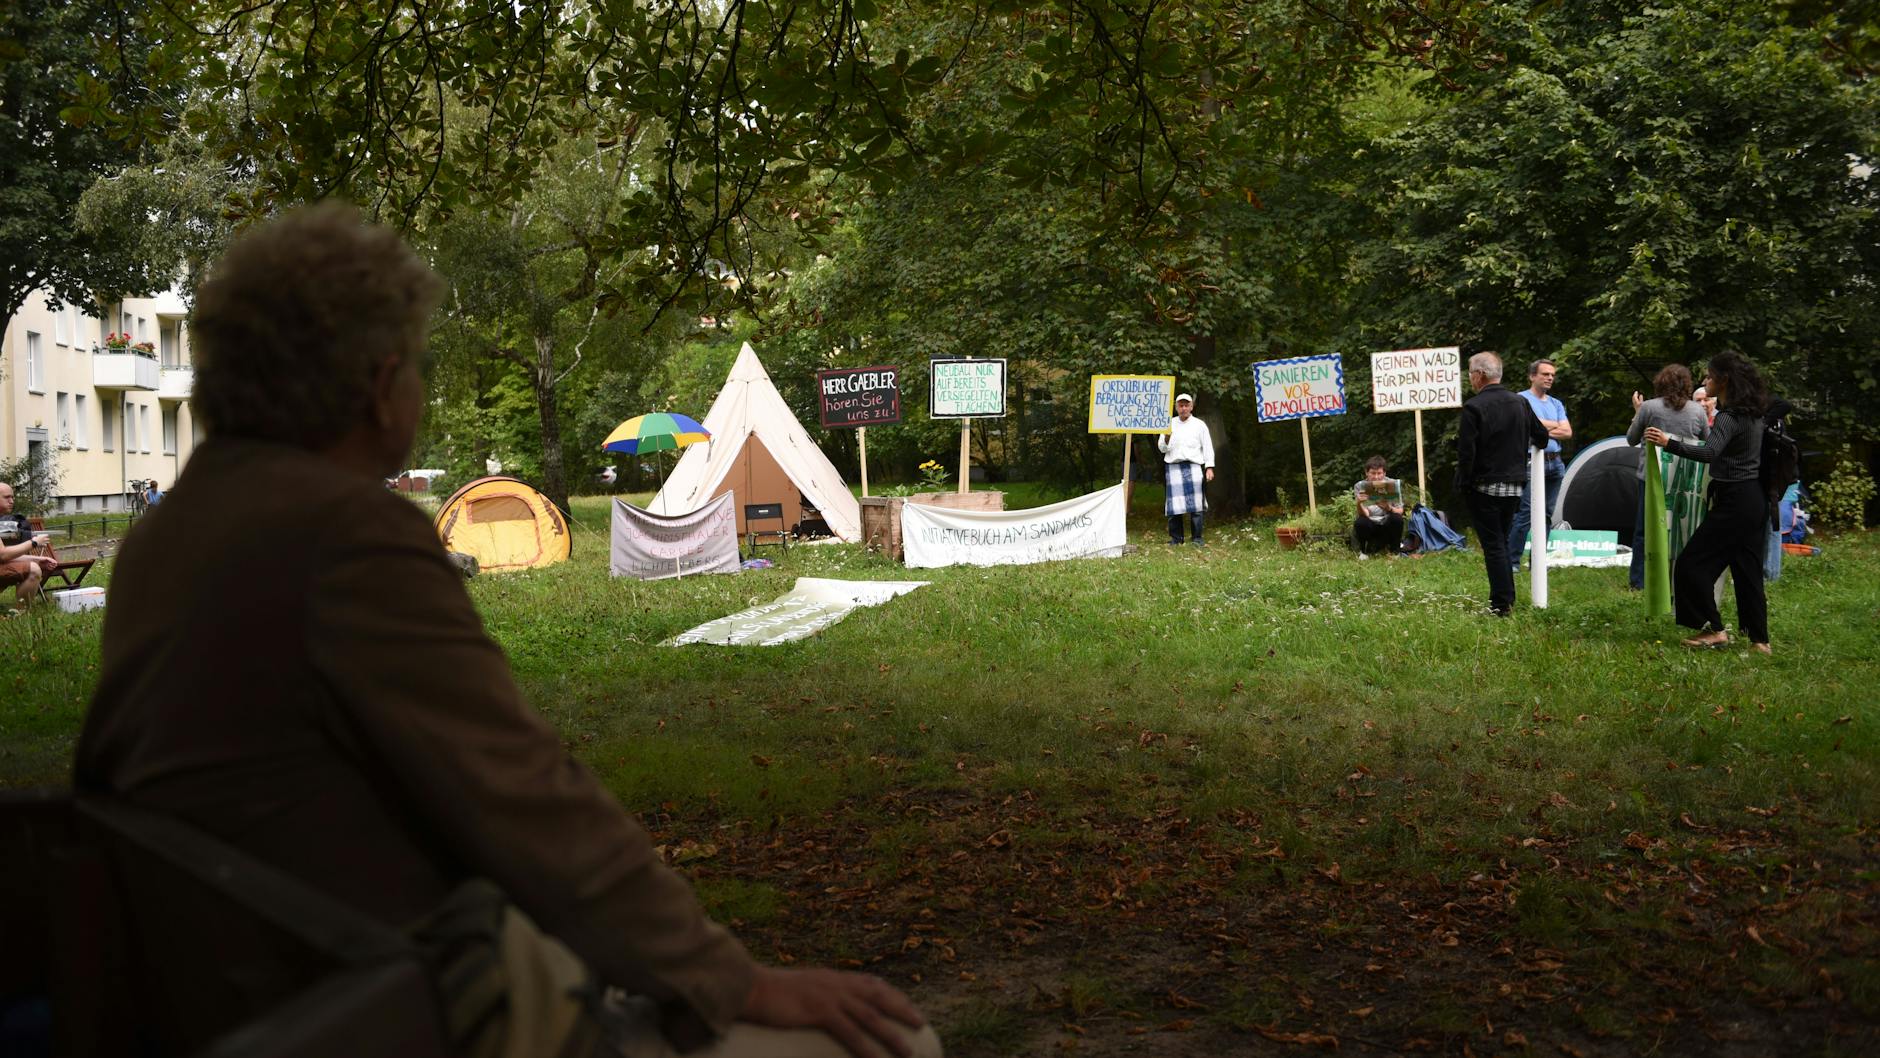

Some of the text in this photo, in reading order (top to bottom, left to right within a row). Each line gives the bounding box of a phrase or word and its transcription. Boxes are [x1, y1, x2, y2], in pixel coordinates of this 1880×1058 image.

[1375, 352, 1458, 371] KEINEN WALD
[976, 364, 995, 376] NUR
[1262, 364, 1329, 386] SANIEREN
[822, 371, 896, 395] HERR GAEBLER
[937, 377, 987, 389] AUF BEREITS
[1398, 371, 1420, 386] DEN
[1283, 382, 1314, 399] VOR
[1377, 387, 1456, 407] BAU RODEN
[861, 392, 883, 407] Sie
[1143, 393, 1169, 407] STATT
[1264, 394, 1343, 416] DEMOLIEREN
[847, 410, 869, 420] uns
[1108, 404, 1132, 417] ENGE
[1003, 525, 1027, 544] AM
[1030, 512, 1093, 540] SANDHAUS
